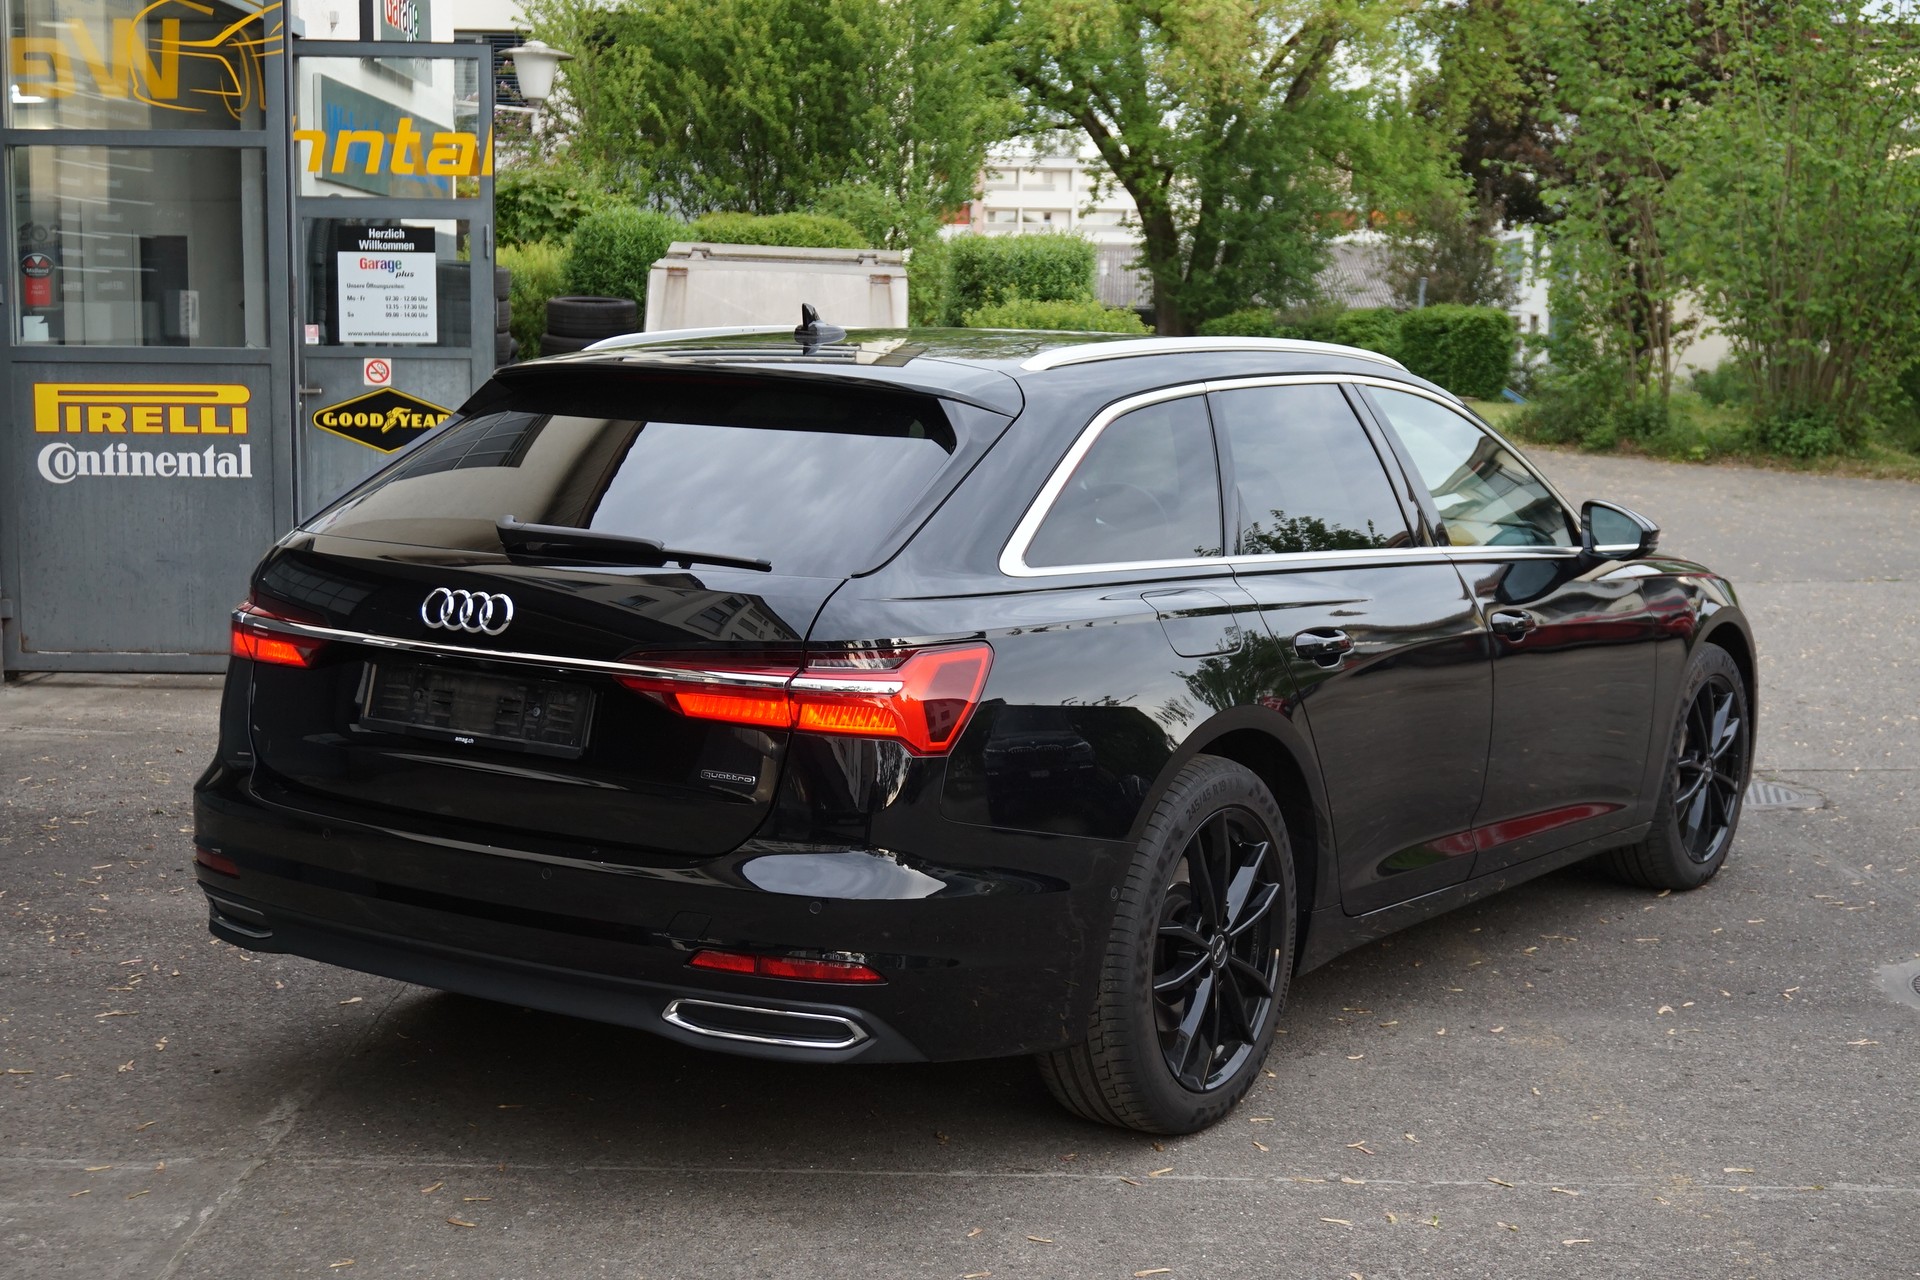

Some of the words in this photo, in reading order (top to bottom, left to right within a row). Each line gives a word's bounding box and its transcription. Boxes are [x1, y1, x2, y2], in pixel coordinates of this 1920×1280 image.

[368, 228, 405, 239] Herzlich
[358, 239, 415, 251] Willkommen
[359, 257, 402, 273] Garage
[395, 270, 415, 279] plus
[33, 382, 251, 434] PIRELLI
[37, 442, 253, 484] Continental
[703, 771, 752, 783] quattro
